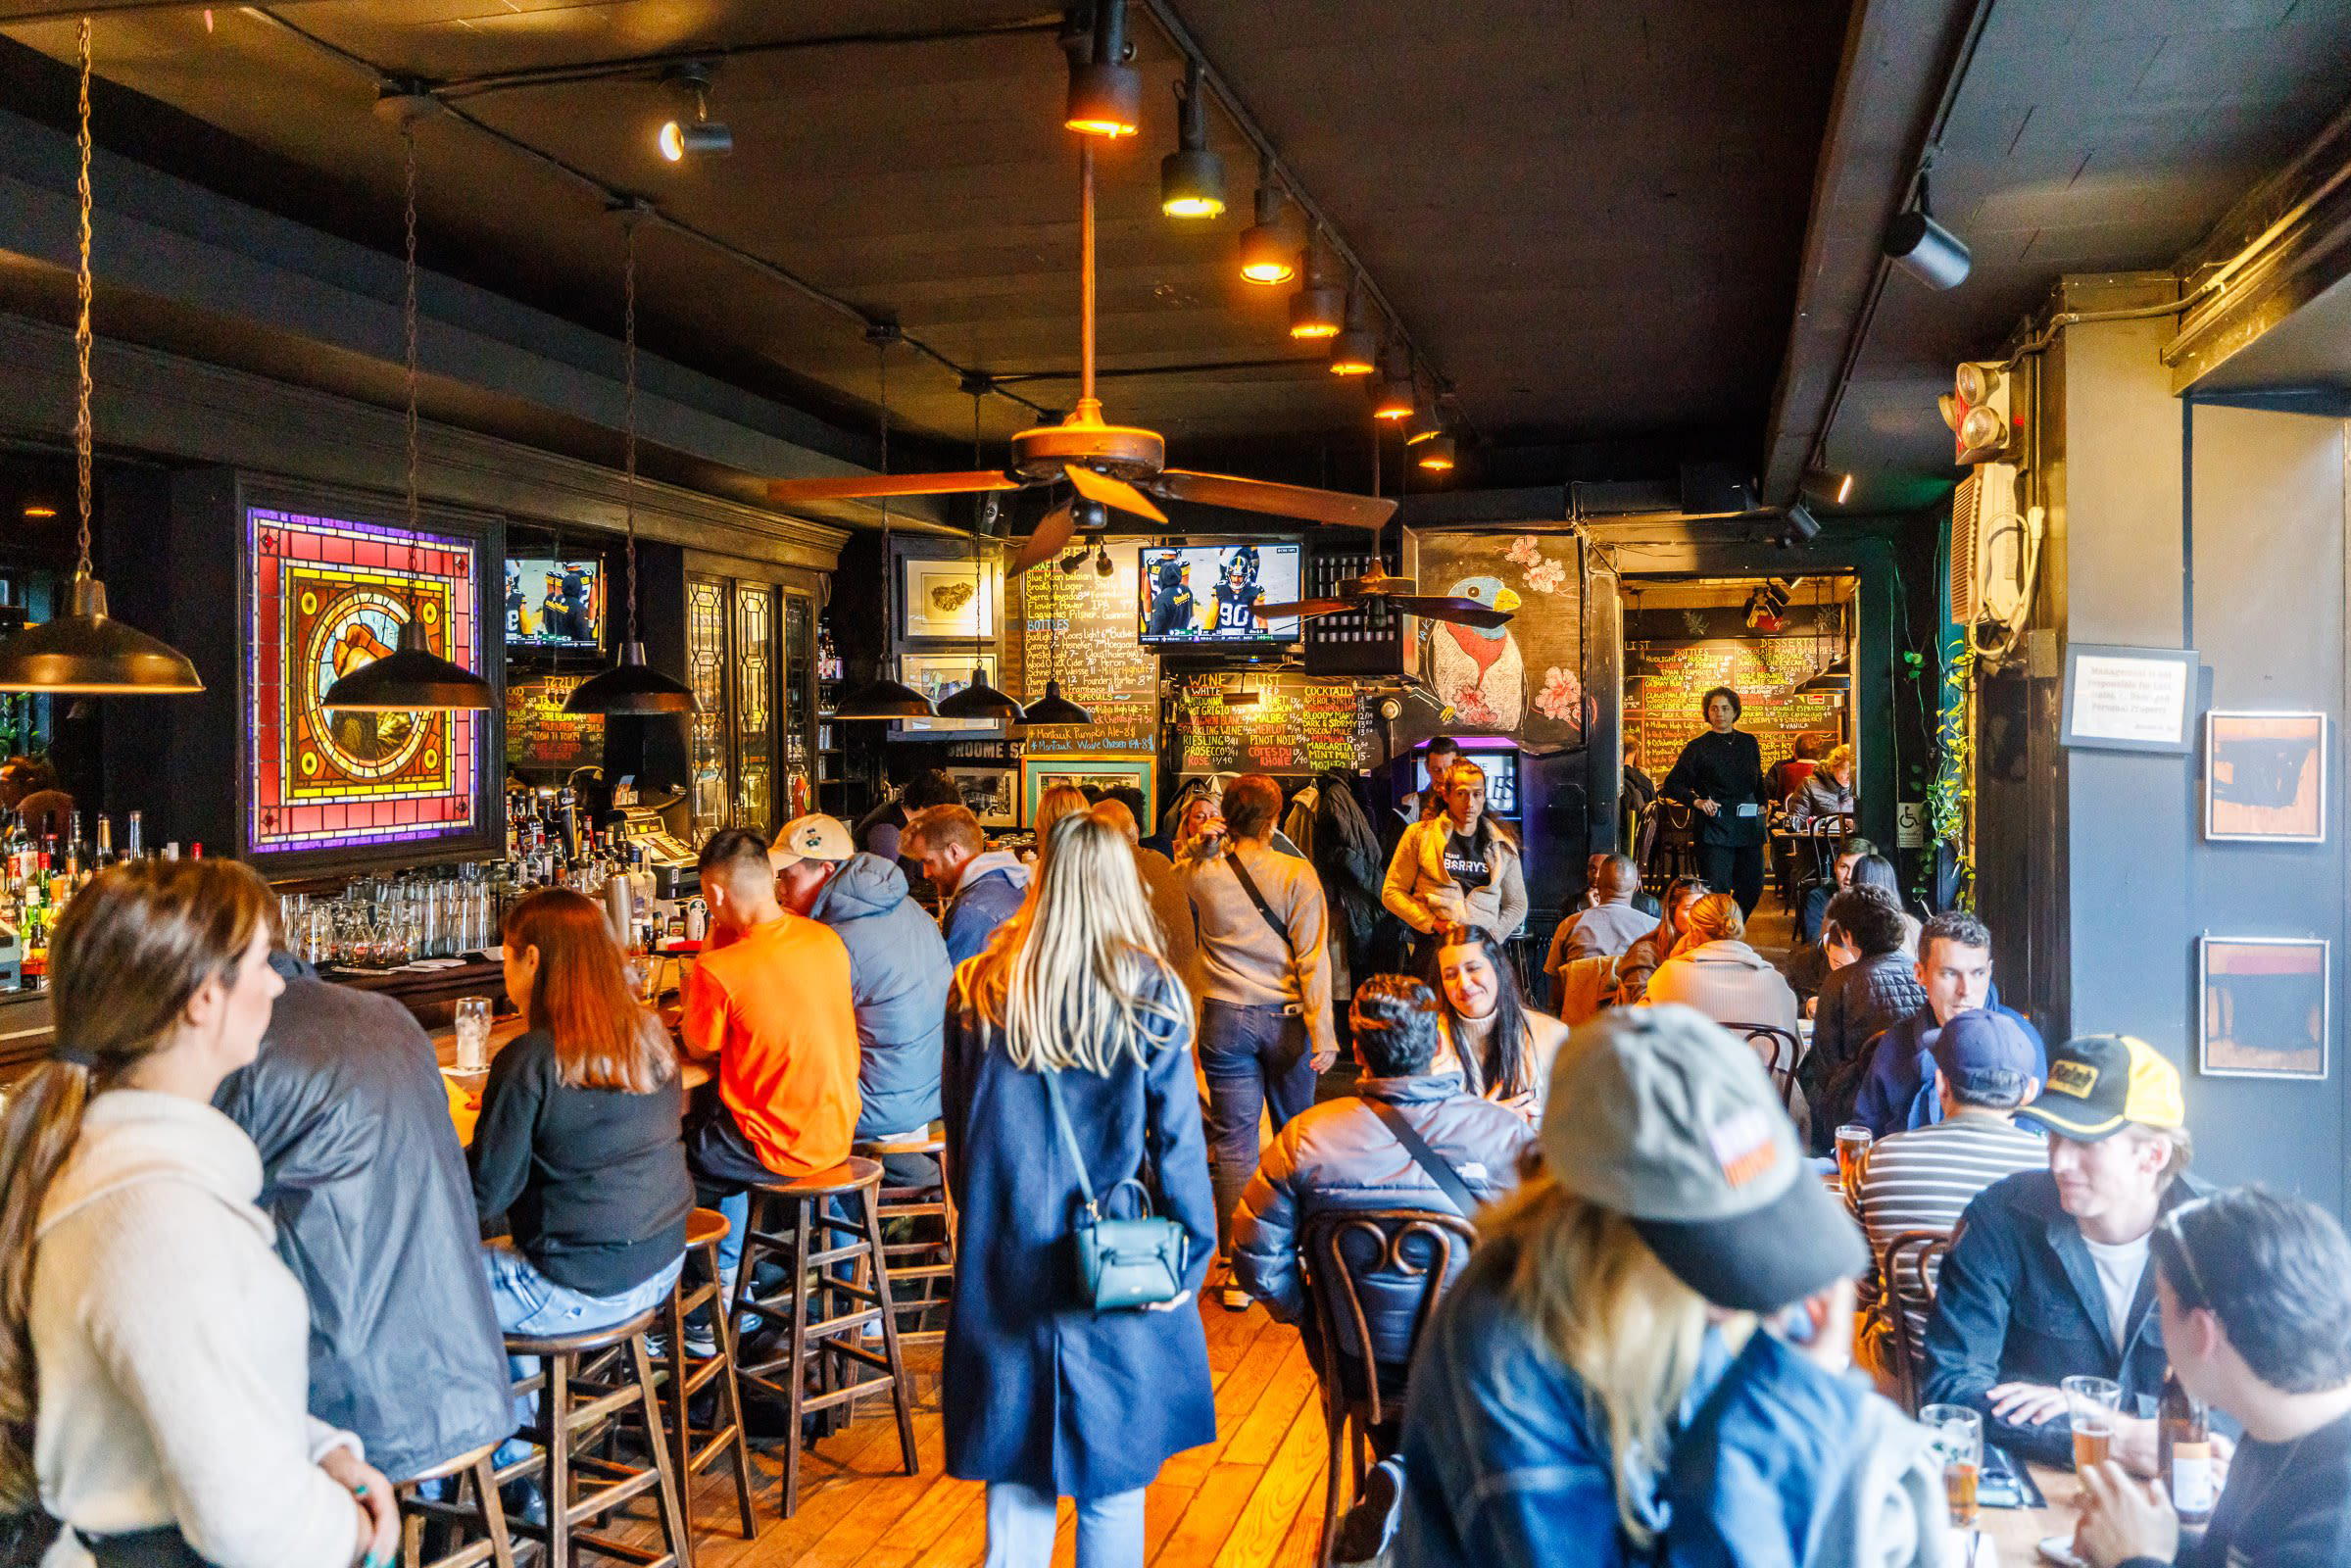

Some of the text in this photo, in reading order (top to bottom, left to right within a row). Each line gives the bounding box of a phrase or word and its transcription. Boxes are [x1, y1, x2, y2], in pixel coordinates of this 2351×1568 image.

[1062, 546, 1102, 561] BER
[1026, 571, 1043, 581] Blue
[1060, 582, 1084, 593] Lager
[1026, 592, 1050, 601] Sierra
[1219, 603, 1249, 626] 90
[1027, 618, 1070, 631] BOTTLES
[1026, 642, 1049, 651] Corona
[1760, 638, 1815, 648] DESSERTS
[1674, 648, 1709, 657] BOTTLES
[1026, 659, 1045, 668] Wood
[1045, 659, 1065, 667] Cuck
[1083, 675, 1113, 685] Founders
[1113, 674, 1137, 685] Porter
[1188, 673, 1283, 687] WINE LIST
[1026, 685, 1066, 695] Lindns
[1191, 687, 1222, 696] WHITE
[1304, 686, 1354, 696] COCKTAILS
[1179, 696, 1223, 706] CARDONNA
[1200, 706, 1230, 715] GRIGIO
[1302, 711, 1332, 720] BLOODY
[1334, 711, 1355, 720] MARY
[1220, 715, 1243, 726] BLANC
[1254, 712, 1288, 723] MALBEC
[1302, 719, 1320, 728] DARK
[1328, 719, 1357, 728] STORMY
[1037, 728, 1072, 739] Montauk
[1074, 727, 1106, 741] Pumpkin
[1177, 725, 1243, 736] SPARKLING WINE
[1254, 724, 1287, 734] MERLOT
[1333, 727, 1352, 736] MULE
[1039, 739, 1073, 751] Montauk
[1183, 735, 1224, 745] RIESLING
[1249, 735, 1297, 745] PINOT NOIR
[1184, 745, 1225, 757] PROSECCO
[1306, 742, 1353, 752] MARGARITA
[1308, 750, 1334, 760] MINT
[1335, 750, 1356, 760] MULE
[1188, 756, 1210, 765] ROSE
